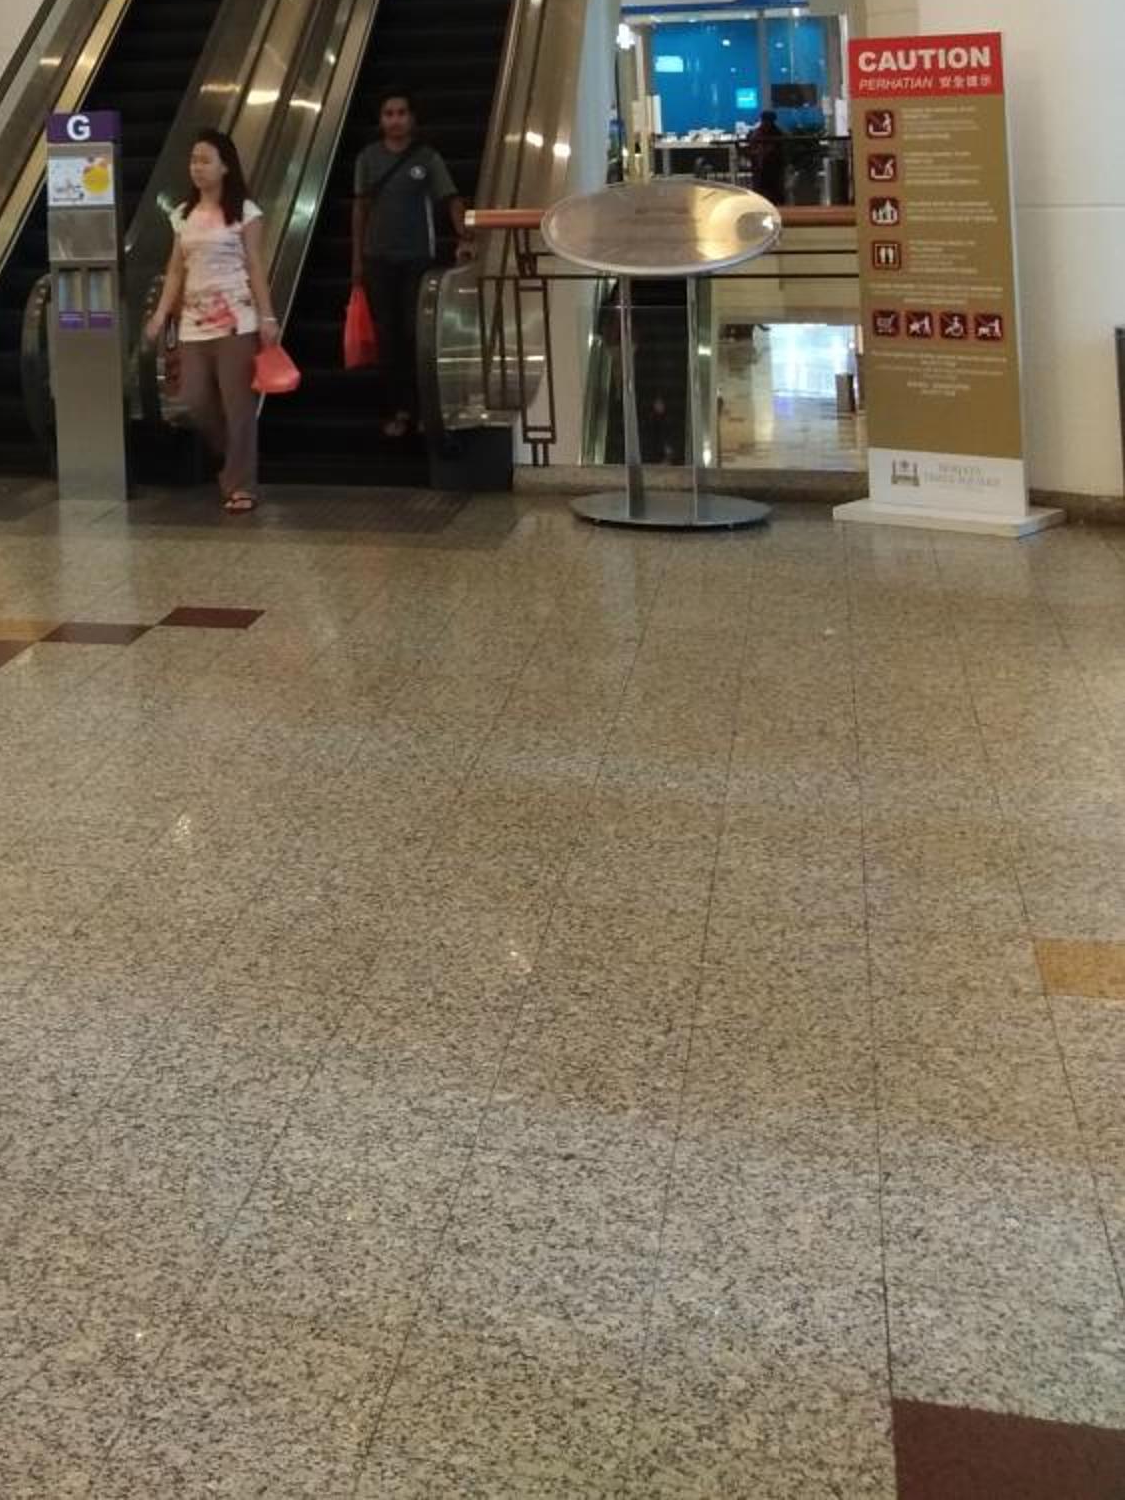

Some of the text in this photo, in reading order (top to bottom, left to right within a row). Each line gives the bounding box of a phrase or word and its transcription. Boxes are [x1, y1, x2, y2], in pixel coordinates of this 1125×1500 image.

[858, 46, 991, 73] CAUTION
[858, 76, 933, 91] PERHATIAN
[66, 115, 91, 140] G
